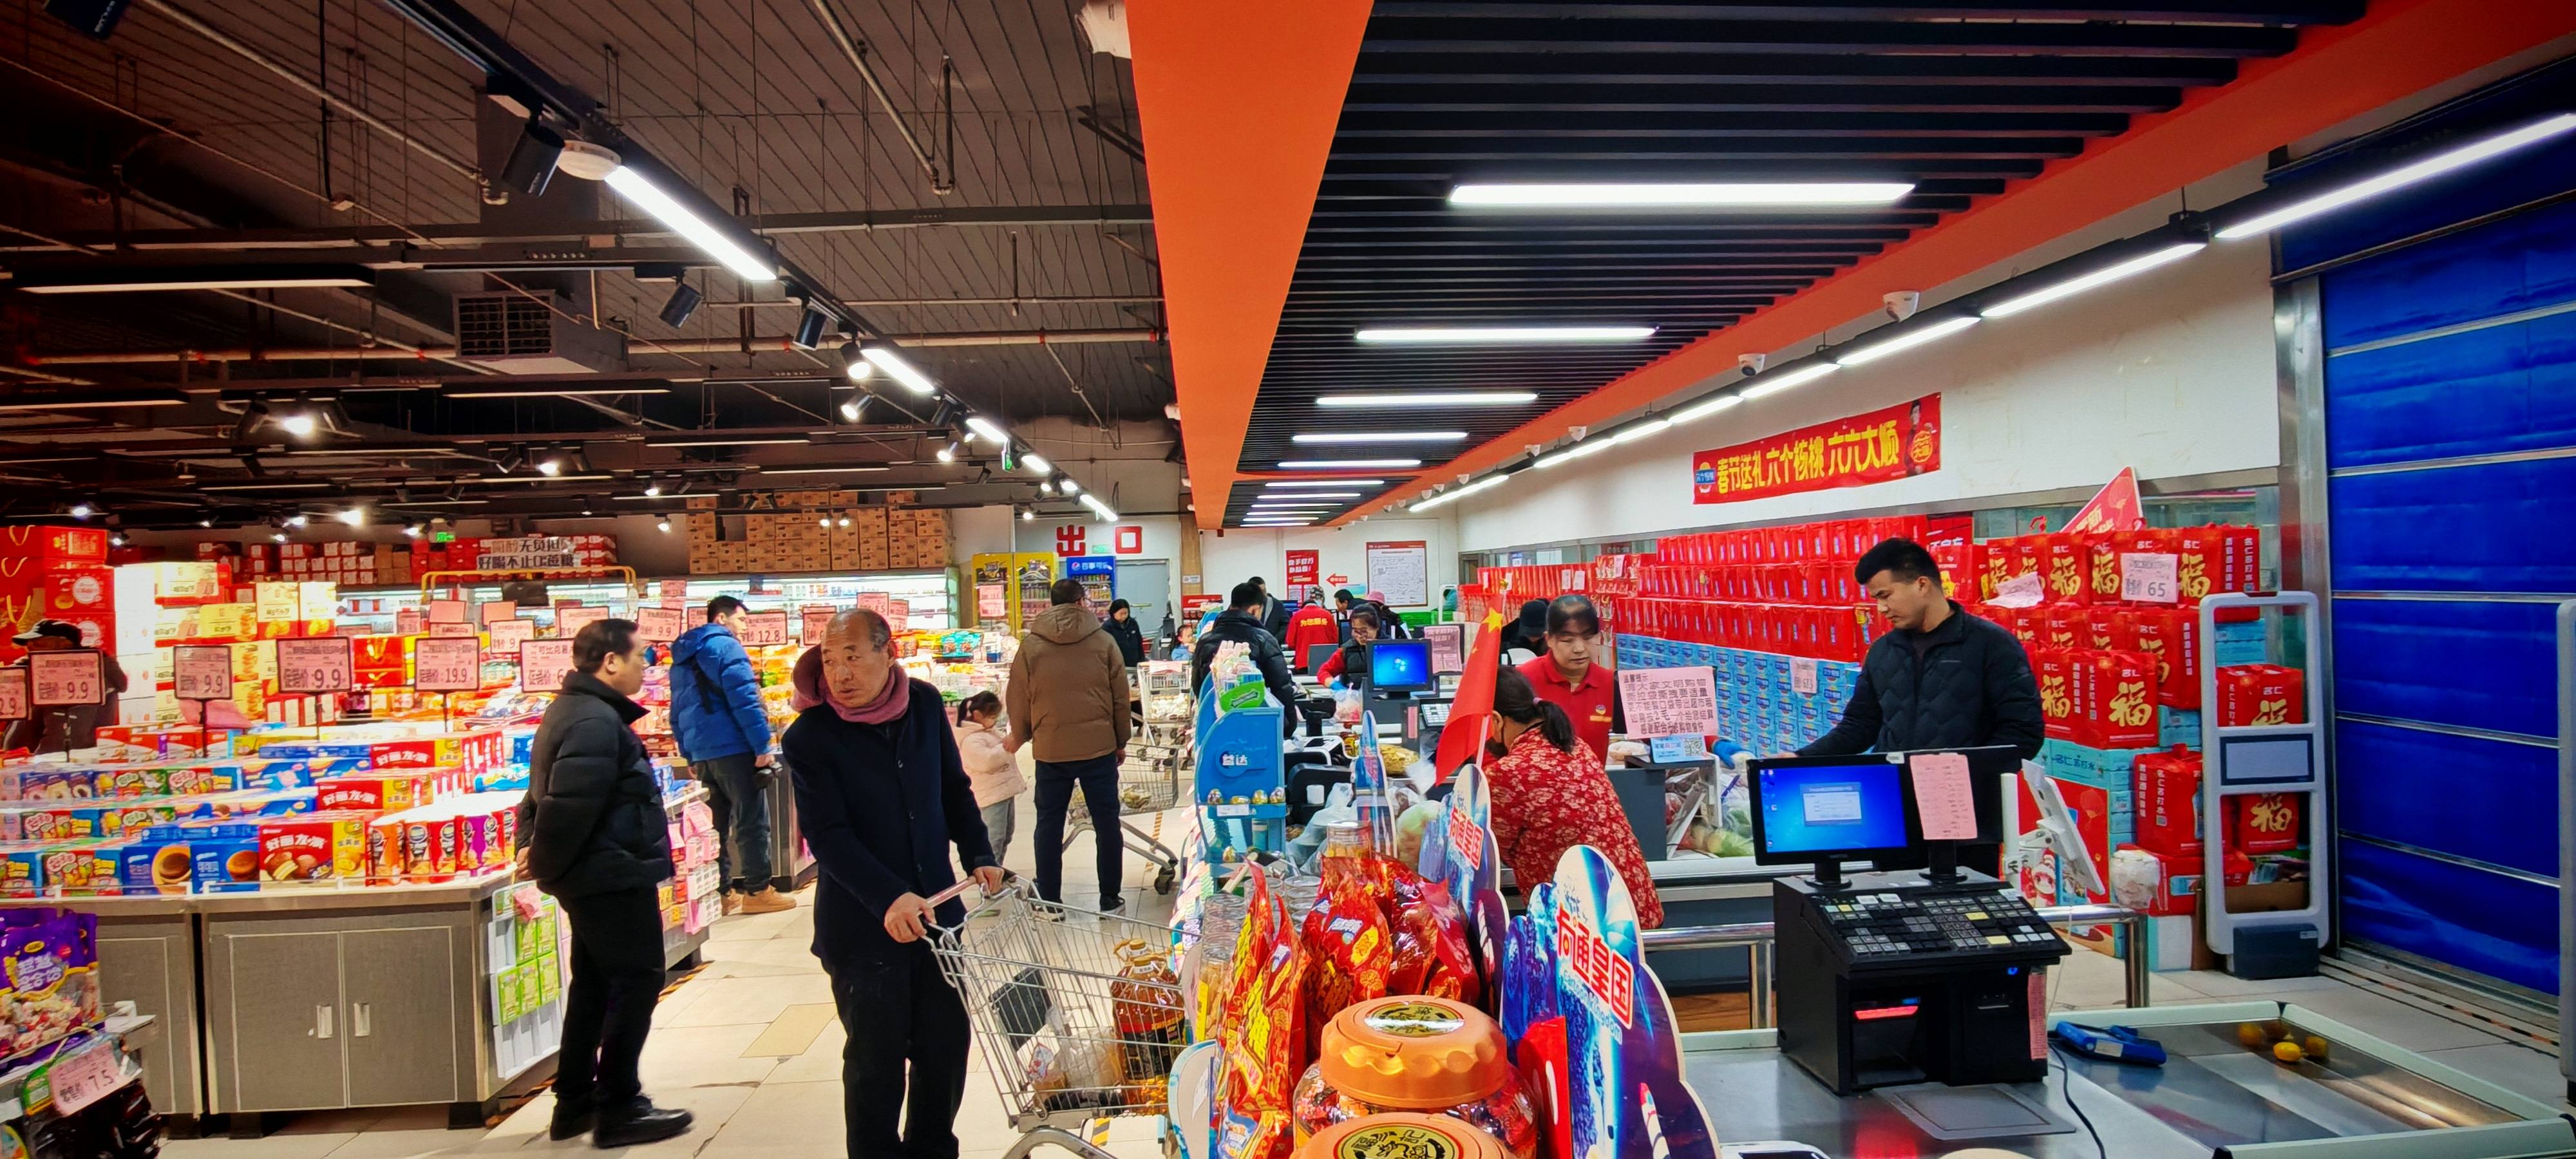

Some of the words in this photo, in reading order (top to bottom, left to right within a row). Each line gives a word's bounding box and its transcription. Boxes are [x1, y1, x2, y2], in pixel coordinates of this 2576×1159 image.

[1828, 419, 1899, 476] 六六大顺
[1057, 524, 1142, 557] 出口
[2050, 556, 2081, 596] 福
[2092, 551, 2119, 594] 福
[2148, 581, 2166, 597] 65
[2179, 553, 2211, 598] 福
[758, 630, 781, 643] 12.8
[67, 681, 89, 700] 9.9
[204, 674, 223, 693] 9.9
[314, 668, 342, 688] 9.9
[445, 667, 468, 684] 19.9
[2040, 674, 2071, 719] 福
[2108, 681, 2153, 727] 福
[1222, 754, 1248, 766] 益达
[2249, 793, 2293, 833] 福
[1450, 807, 1483, 870] 卡通皇国
[1557, 903, 1633, 1029] 卡通皇国
[88, 1069, 114, 1093] 7.5
